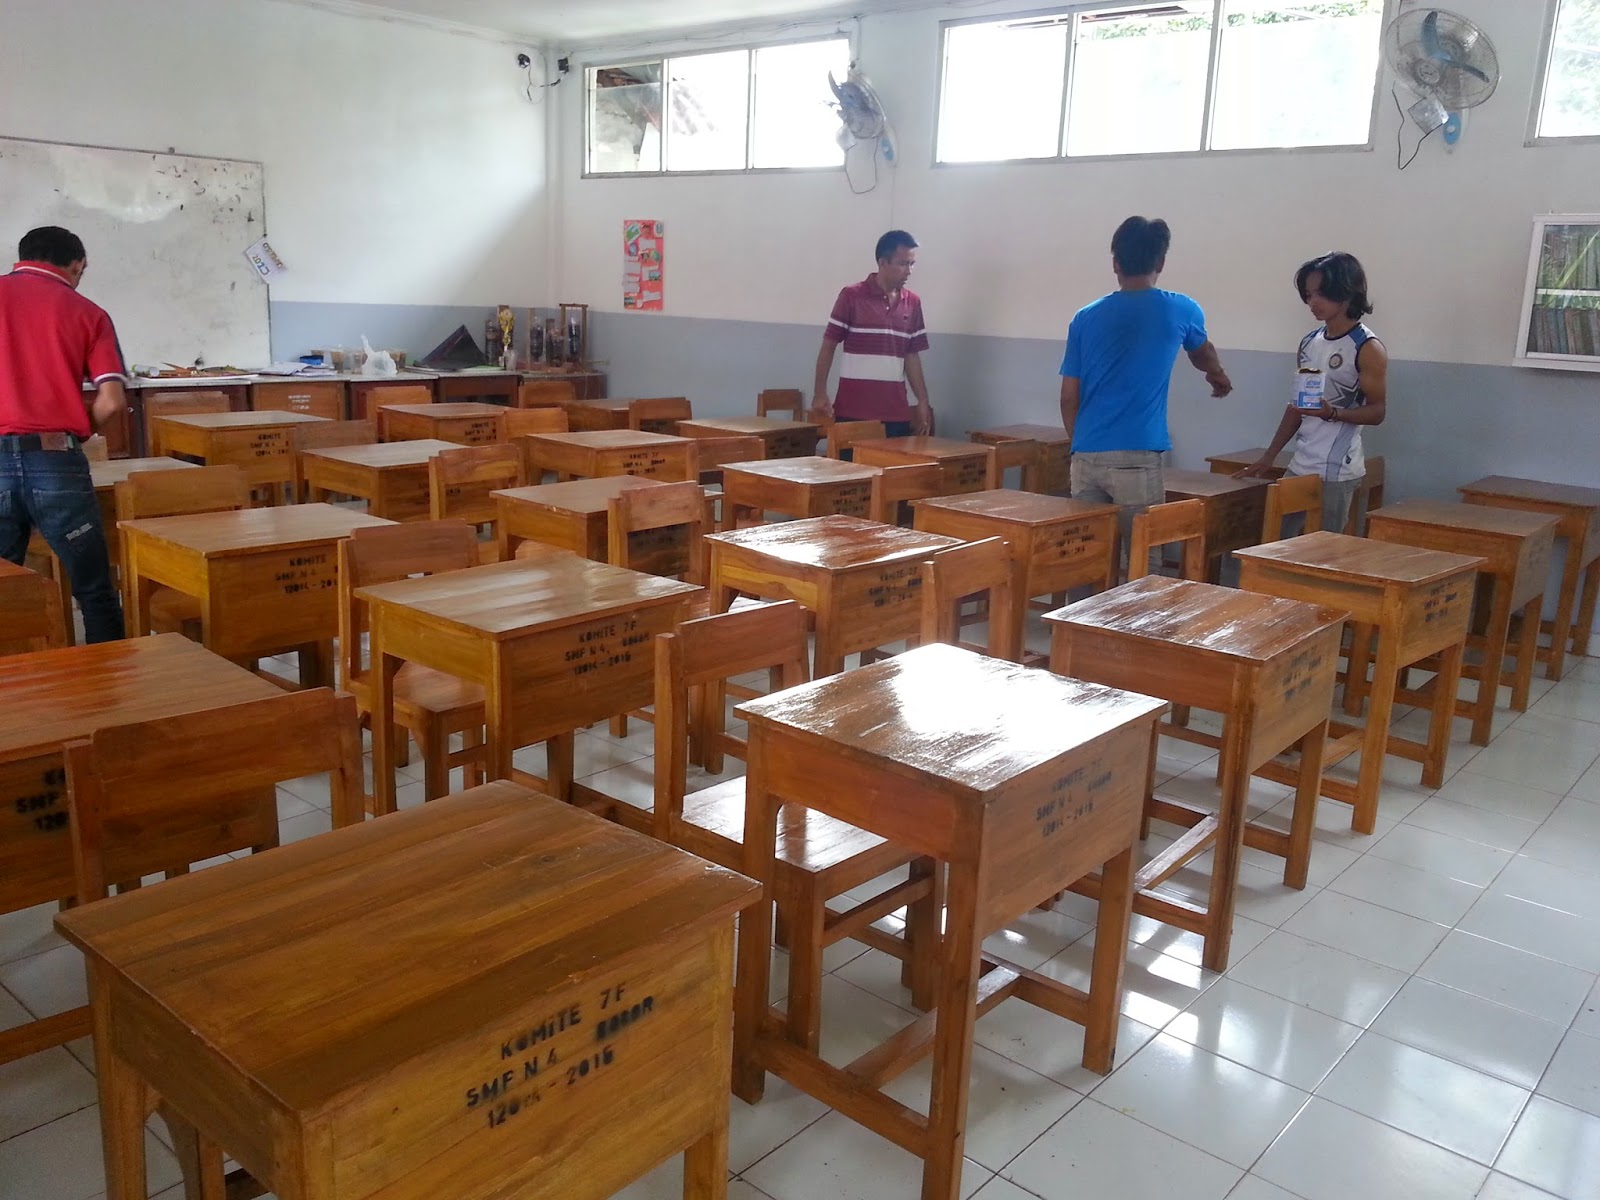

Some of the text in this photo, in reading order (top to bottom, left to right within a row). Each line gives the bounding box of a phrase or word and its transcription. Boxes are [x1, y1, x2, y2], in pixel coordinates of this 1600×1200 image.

[579, 625, 615, 643] KOMITE
[501, 1003, 581, 1060] KOMITE
[600, 982, 626, 1010] 7F
[524, 1056, 538, 1081] N
